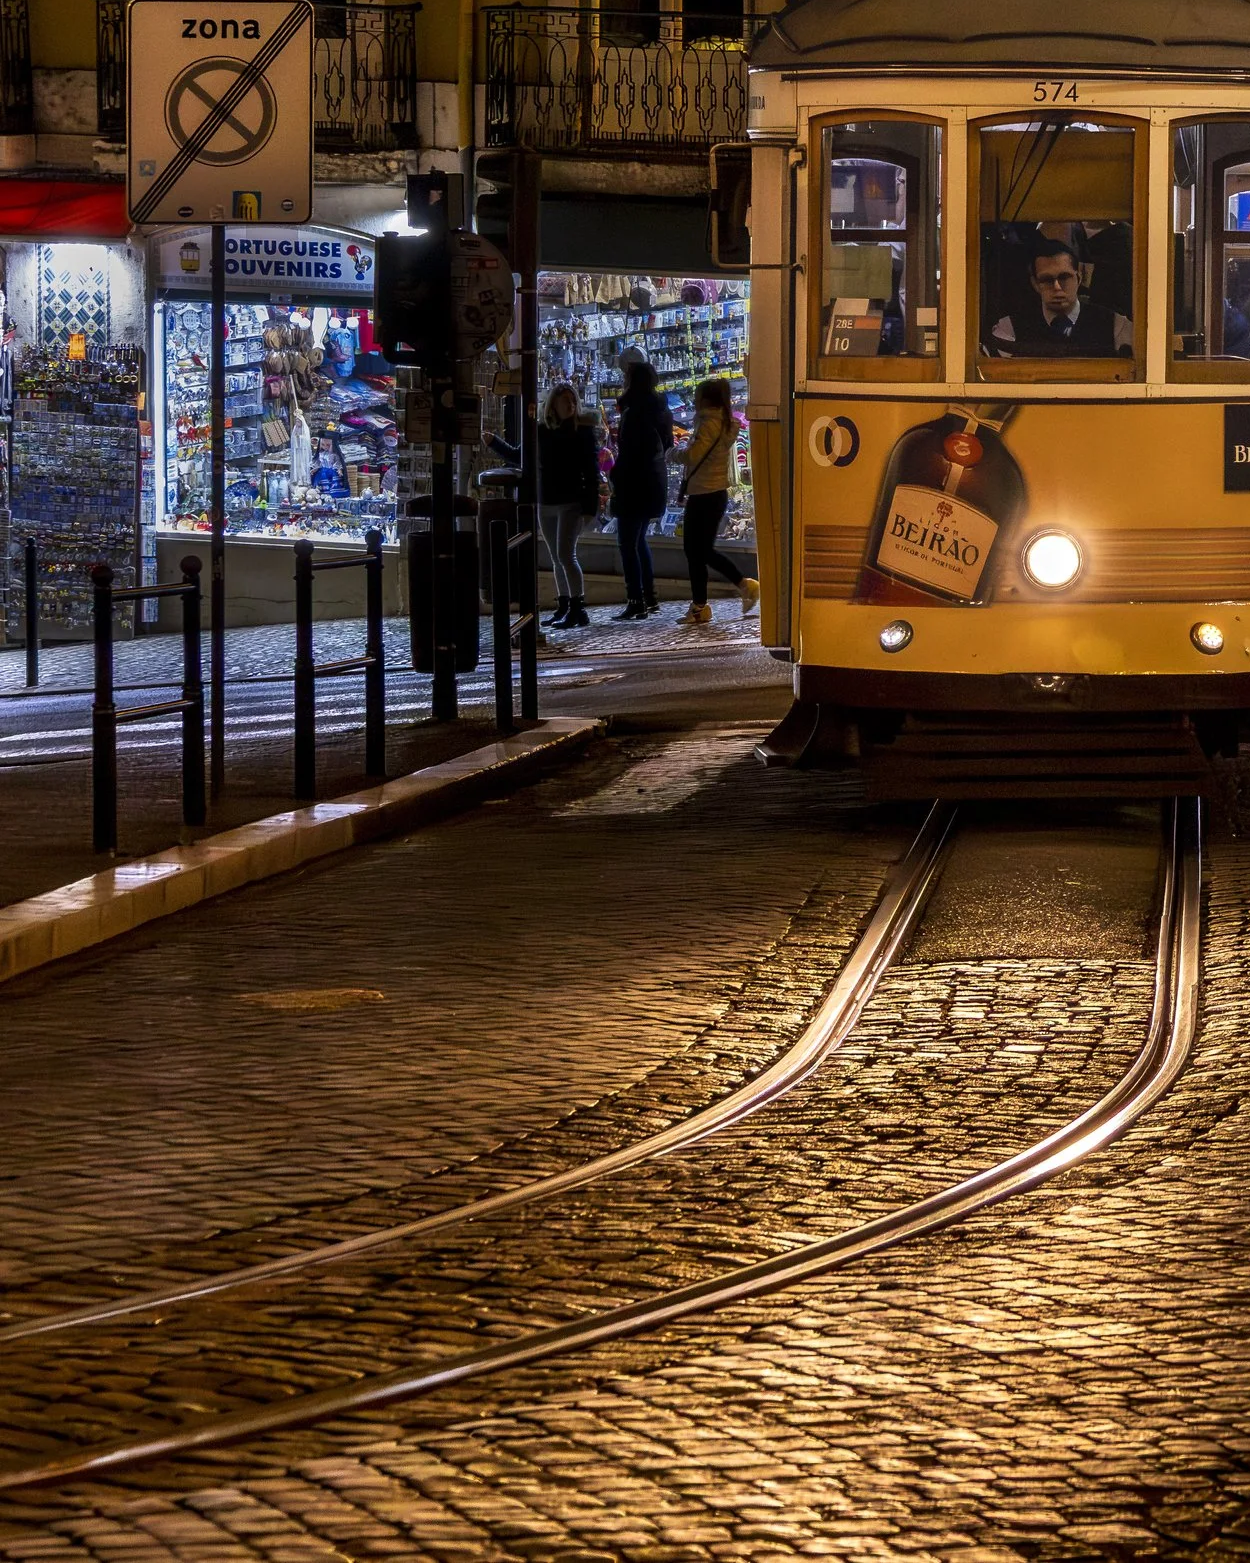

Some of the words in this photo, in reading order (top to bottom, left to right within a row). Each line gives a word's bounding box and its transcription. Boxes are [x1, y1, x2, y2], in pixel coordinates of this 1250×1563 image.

[182, 18, 261, 40] zona
[1033, 81, 1079, 103] 574
[224, 239, 342, 258] ORTUGUESE
[209, 258, 342, 279] OUVENIRS
[834, 337, 850, 351] 10
[890, 513, 979, 567] BEIRÃO
